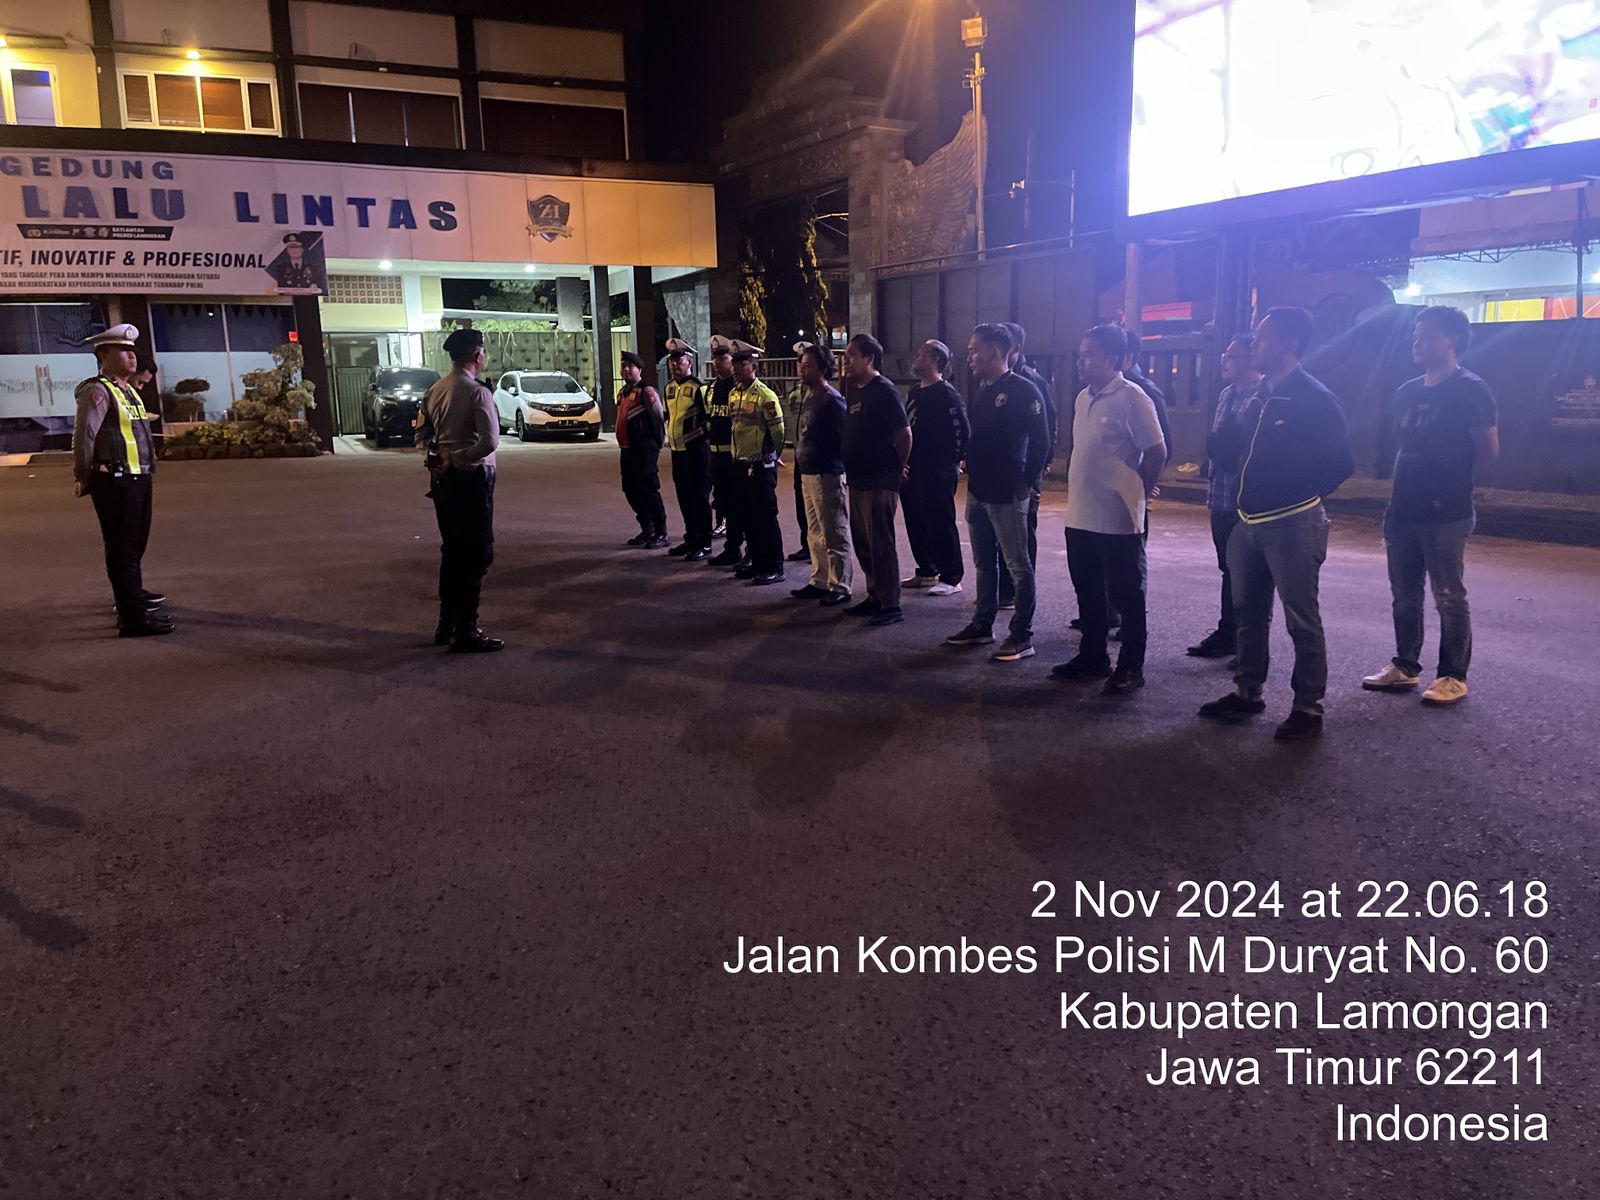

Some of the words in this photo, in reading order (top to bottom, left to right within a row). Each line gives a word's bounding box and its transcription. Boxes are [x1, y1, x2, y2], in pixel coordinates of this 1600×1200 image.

[0, 156, 174, 180] GEDUNG
[22, 185, 185, 221] LALU
[234, 192, 458, 231] LINTAS
[0, 250, 23, 268] IF,
[30, 250, 116, 266] INOVATIF
[122, 250, 136, 266] &
[143, 251, 267, 268] PROFESIONAL
